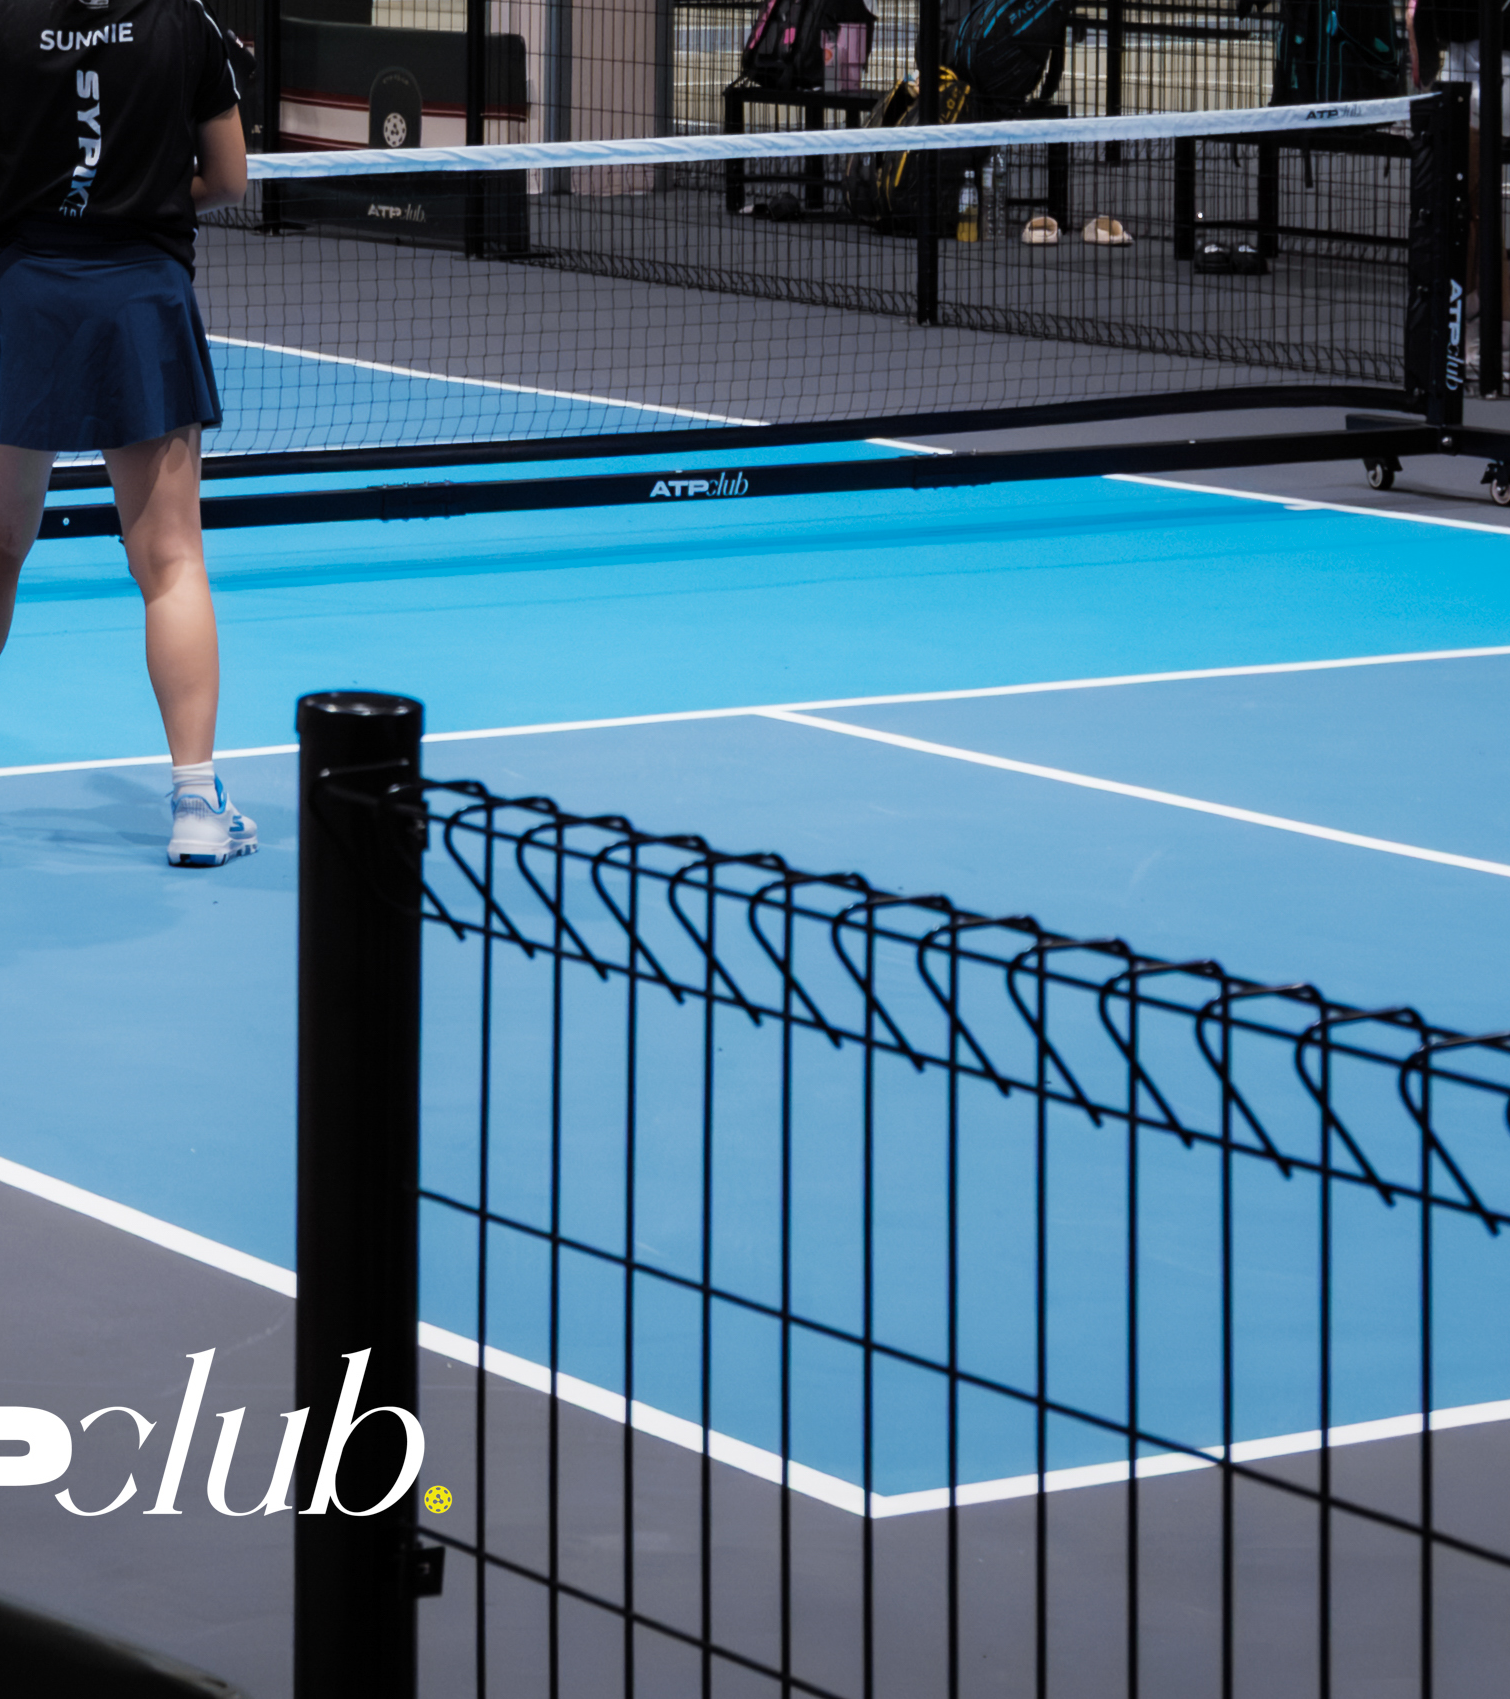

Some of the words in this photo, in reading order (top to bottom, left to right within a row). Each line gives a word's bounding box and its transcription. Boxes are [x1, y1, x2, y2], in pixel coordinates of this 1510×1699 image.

[40, 22, 134, 51] SUNNIE
[1445, 278, 1465, 391] ATPclub
[649, 471, 750, 498] ATPclub
